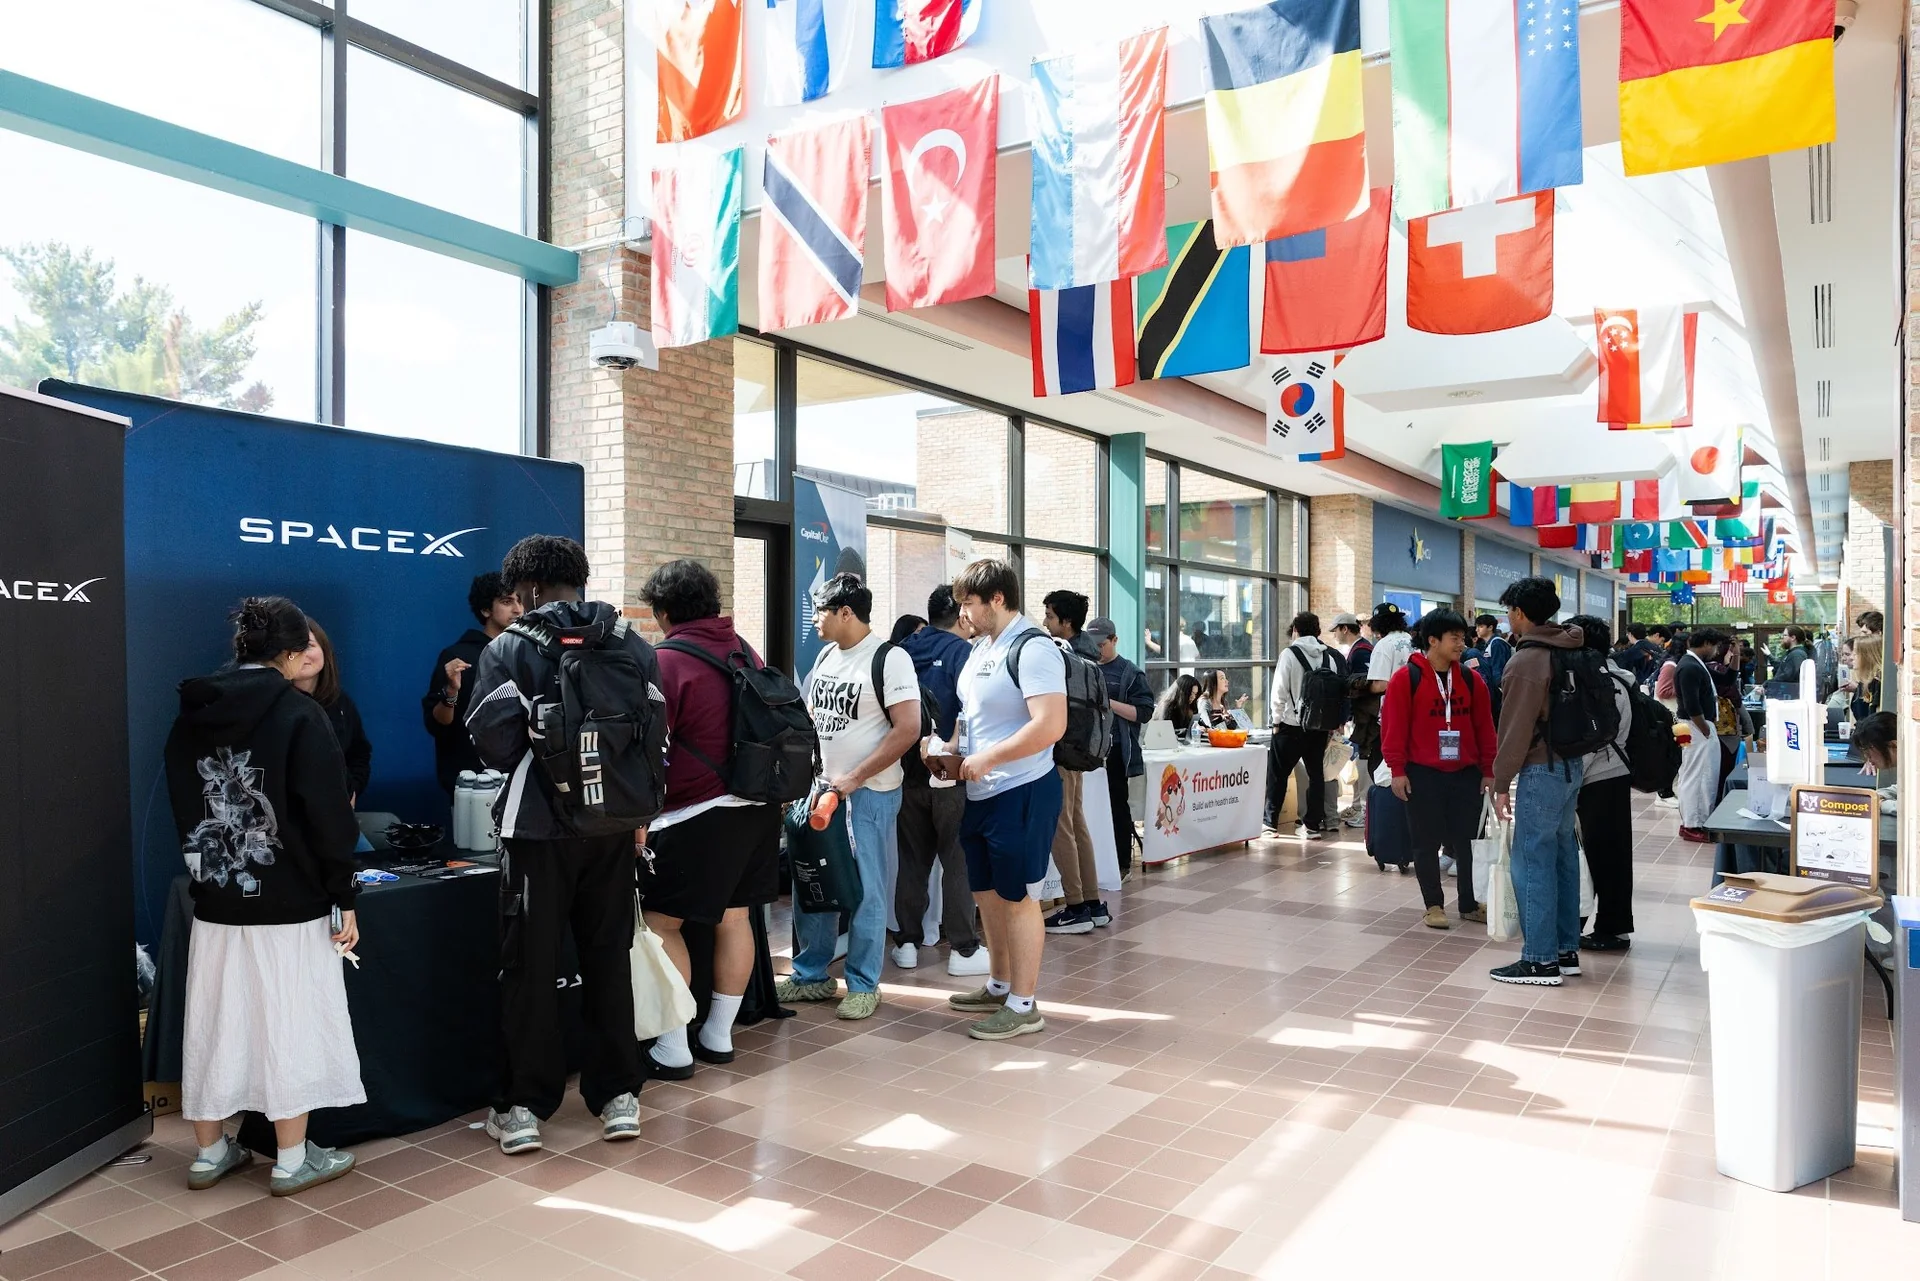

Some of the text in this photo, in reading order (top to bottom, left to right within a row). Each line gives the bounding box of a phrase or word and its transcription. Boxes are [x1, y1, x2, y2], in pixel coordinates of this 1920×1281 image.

[239, 517, 489, 557] SPACEX
[1192, 766, 1249, 793] finchnode
[1192, 801, 1203, 811] Build
[1204, 799, 1214, 809] with
[1215, 798, 1228, 807] health
[1820, 798, 1869, 812] Compost
[1710, 894, 1744, 903] Compost
